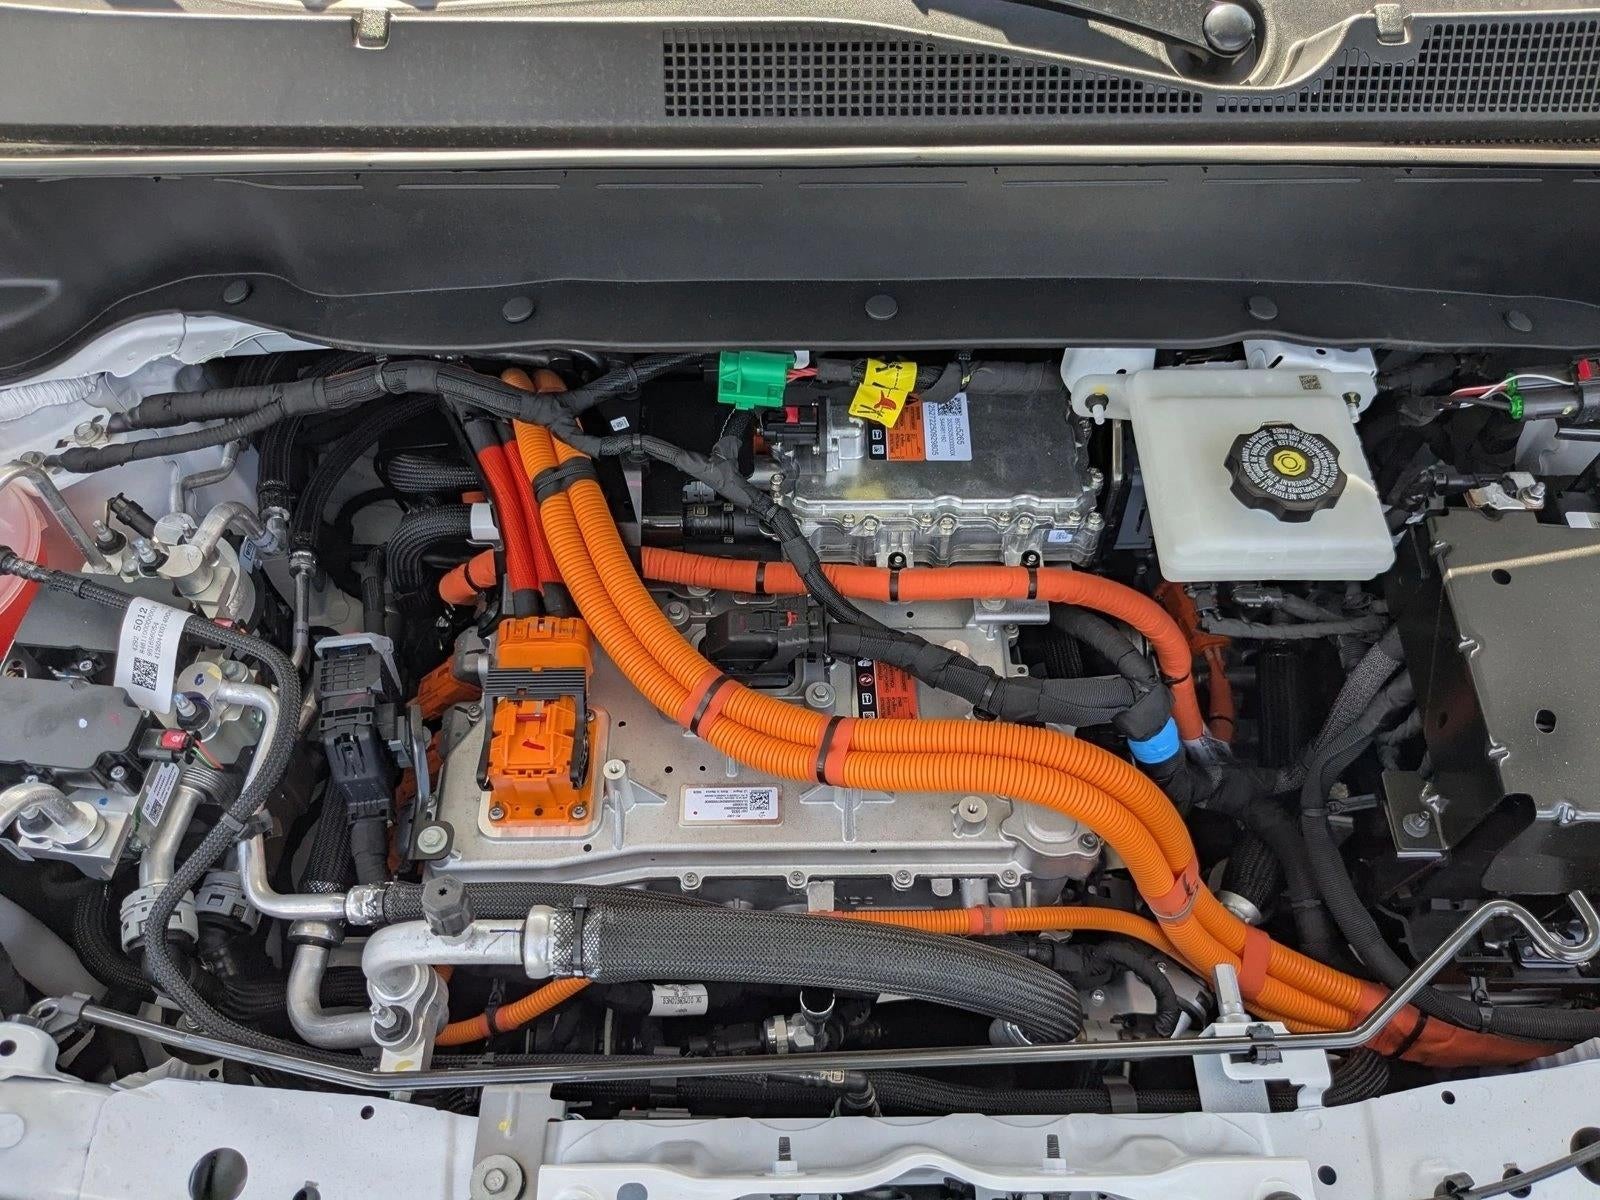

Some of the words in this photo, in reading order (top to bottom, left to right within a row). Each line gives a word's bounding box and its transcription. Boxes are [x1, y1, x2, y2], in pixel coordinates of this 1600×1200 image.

[1296, 442, 1315, 456] CLEAN
[1265, 486, 1297, 499] NETTOYER
[1273, 482, 1285, 491] QUE
[133, 607, 148, 632] 5012
